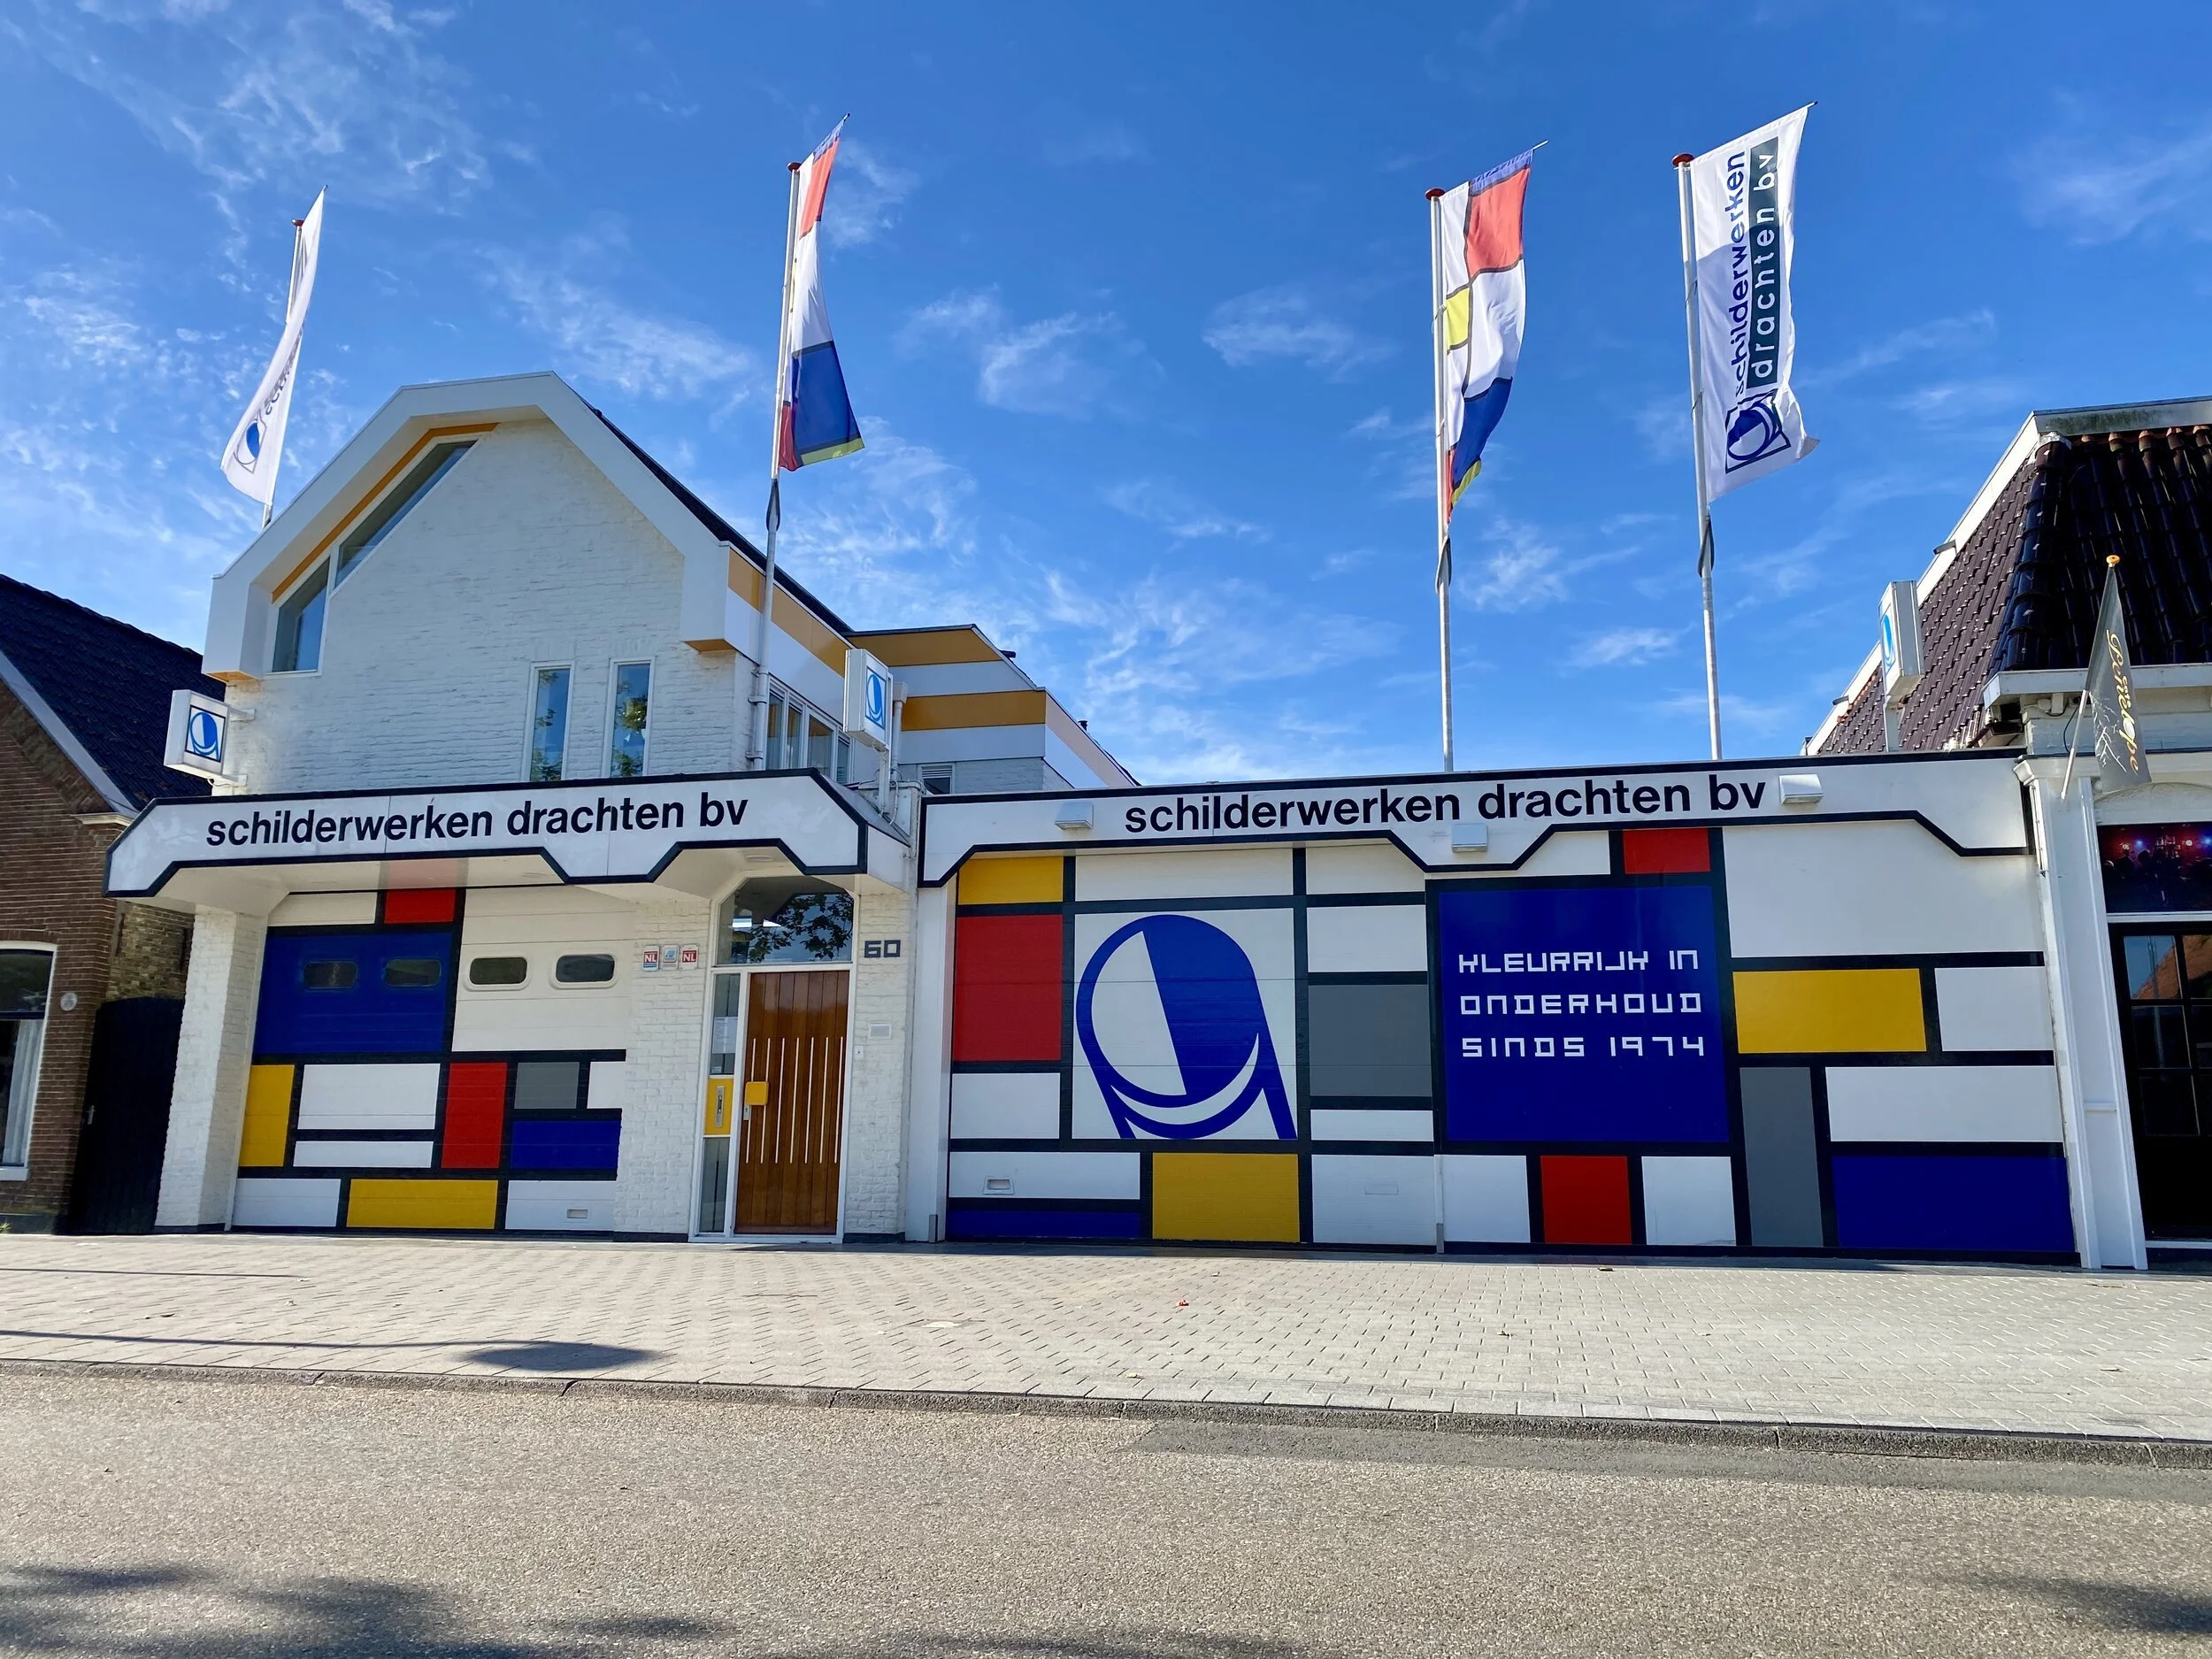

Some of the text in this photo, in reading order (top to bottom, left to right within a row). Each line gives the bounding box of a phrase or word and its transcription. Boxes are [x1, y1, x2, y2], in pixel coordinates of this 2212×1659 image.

[1724, 150, 1749, 397] schilderwerken
[1749, 153, 1777, 379] drachten bv
[1125, 773, 1766, 833] schilderwerken drachten bv
[205, 792, 749, 847] schilderwerken drachten bv
[644, 954, 657, 963] NL
[683, 953, 695, 962] NL
[864, 939, 902, 959] 60
[1458, 949, 1699, 973] KLEURRIJK IN
[1460, 993, 1701, 1015] ONDERHOUD
[1462, 1036, 1704, 1057] SINDS 1974
